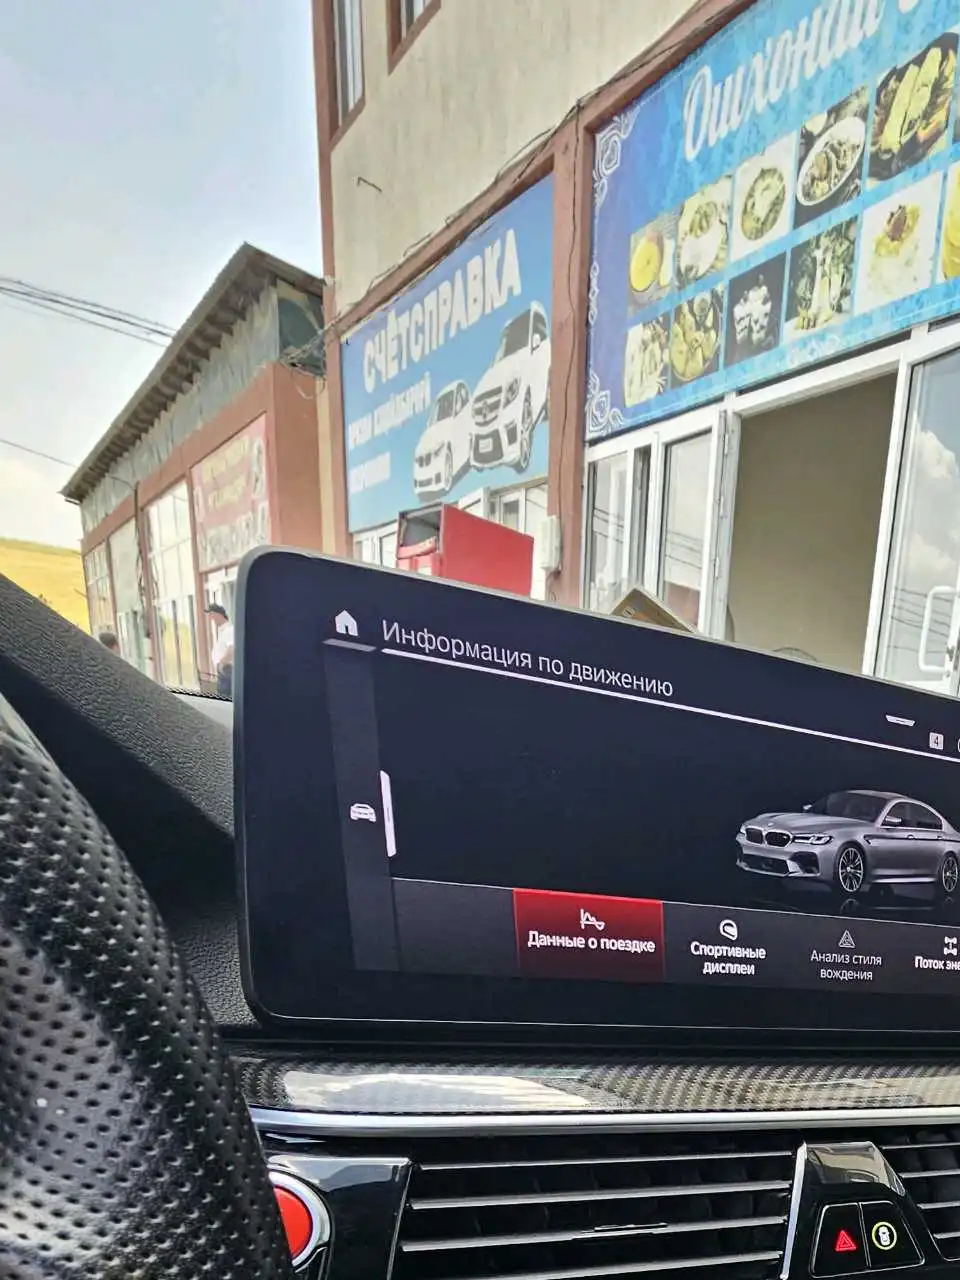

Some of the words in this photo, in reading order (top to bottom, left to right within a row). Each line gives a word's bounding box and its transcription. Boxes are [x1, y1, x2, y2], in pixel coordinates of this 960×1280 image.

[382, 619, 532, 668] Информация
[538, 655, 564, 675] по
[569, 662, 674, 697] движению
[527, 930, 586, 949] Данные
[588, 938, 598, 949] о
[600, 938, 656, 953] поездке
[690, 941, 767, 961] Спортивные
[810, 950, 850, 964] Анализ
[852, 954, 882, 966] стиля
[703, 961, 755, 975] дисплеи
[914, 955, 945, 970] Поток
[820, 966, 873, 981] вождения
